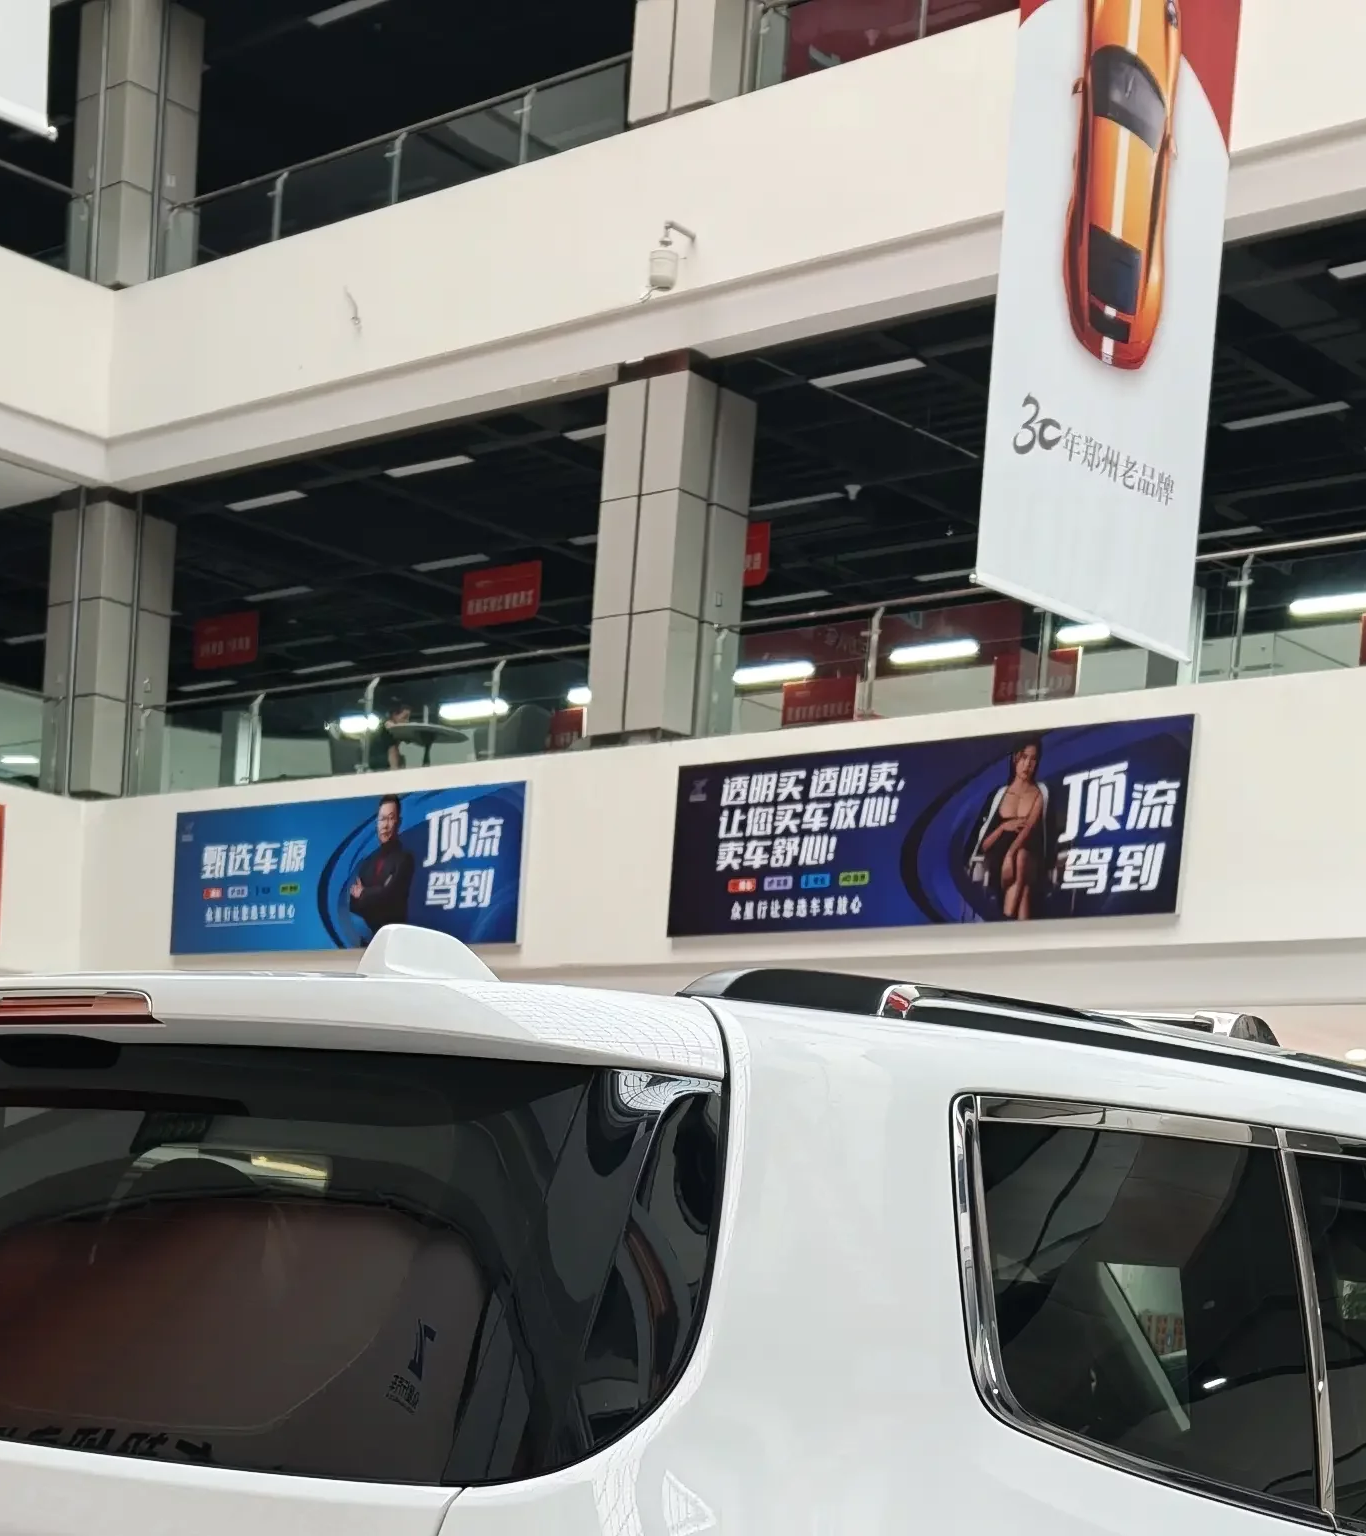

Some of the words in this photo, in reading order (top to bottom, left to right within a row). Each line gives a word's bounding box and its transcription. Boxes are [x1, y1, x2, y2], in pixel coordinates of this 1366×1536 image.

[720, 770, 806, 806] 透明买
[1059, 761, 1180, 842] 顶流
[422, 802, 504, 868] 顶流
[718, 797, 900, 839] 让您买车放心!
[200, 839, 309, 880] 甄选车源
[716, 834, 838, 872] 卖车舒心!
[1061, 842, 1167, 895] 驾到
[425, 868, 495, 910] 驾到
